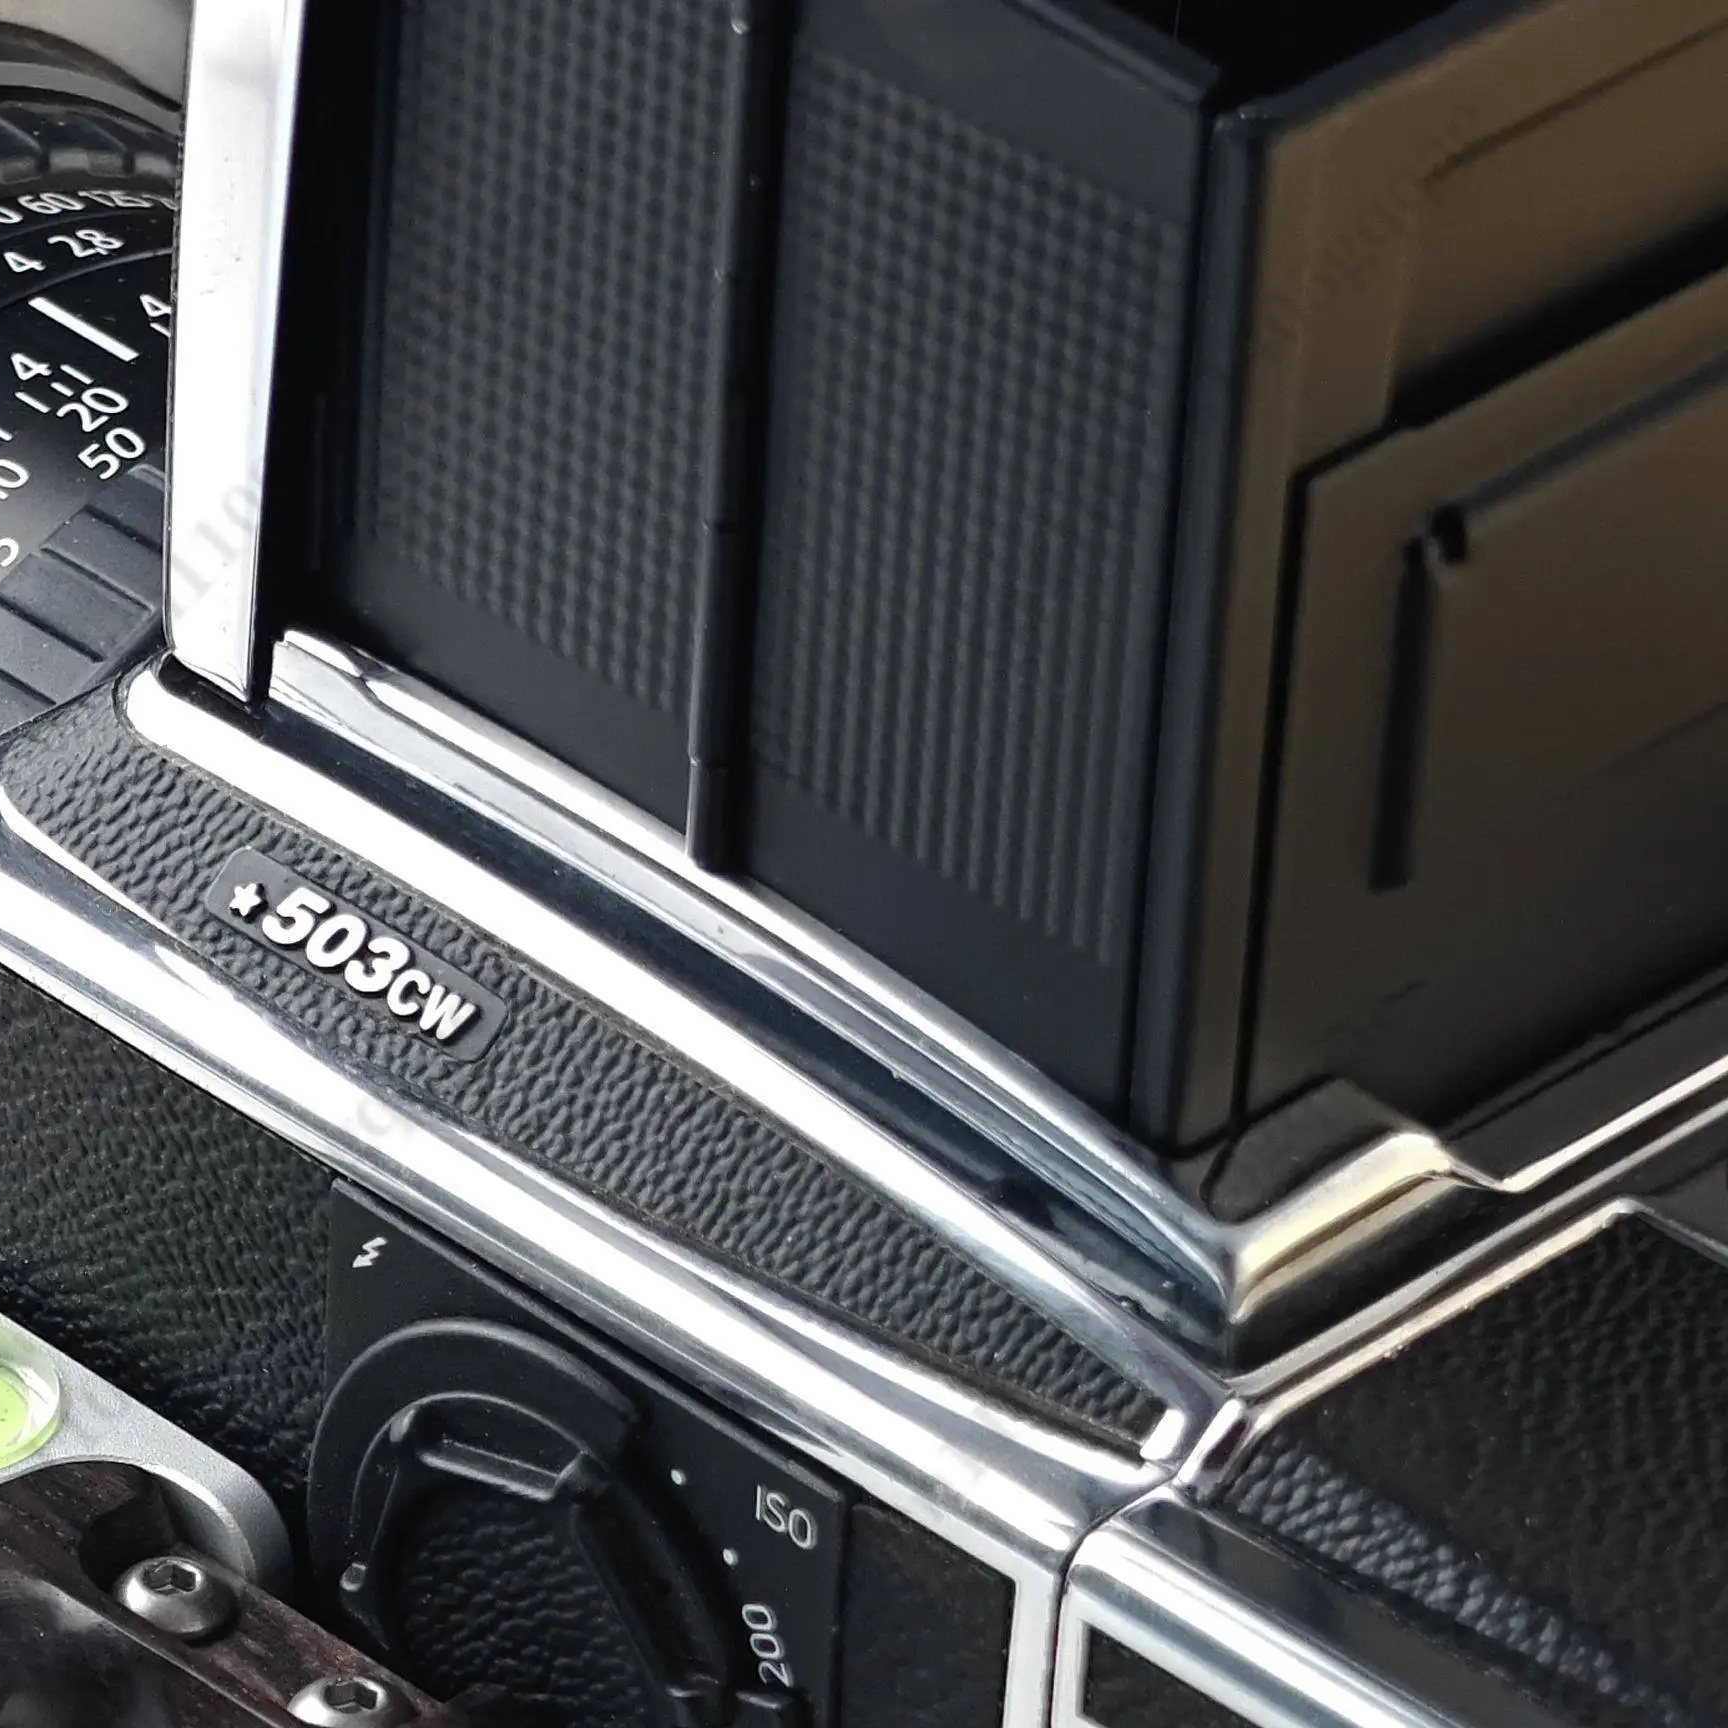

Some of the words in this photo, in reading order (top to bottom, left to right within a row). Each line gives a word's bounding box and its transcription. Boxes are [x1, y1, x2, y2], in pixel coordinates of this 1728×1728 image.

[17, 192, 87, 215] 60
[3, 251, 47, 274] 4
[10, 352, 52, 381] 4
[56, 386, 130, 433] 20
[77, 427, 146, 480] 50
[755, 1484, 818, 1550] ISO
[741, 1603, 795, 1689] 200
